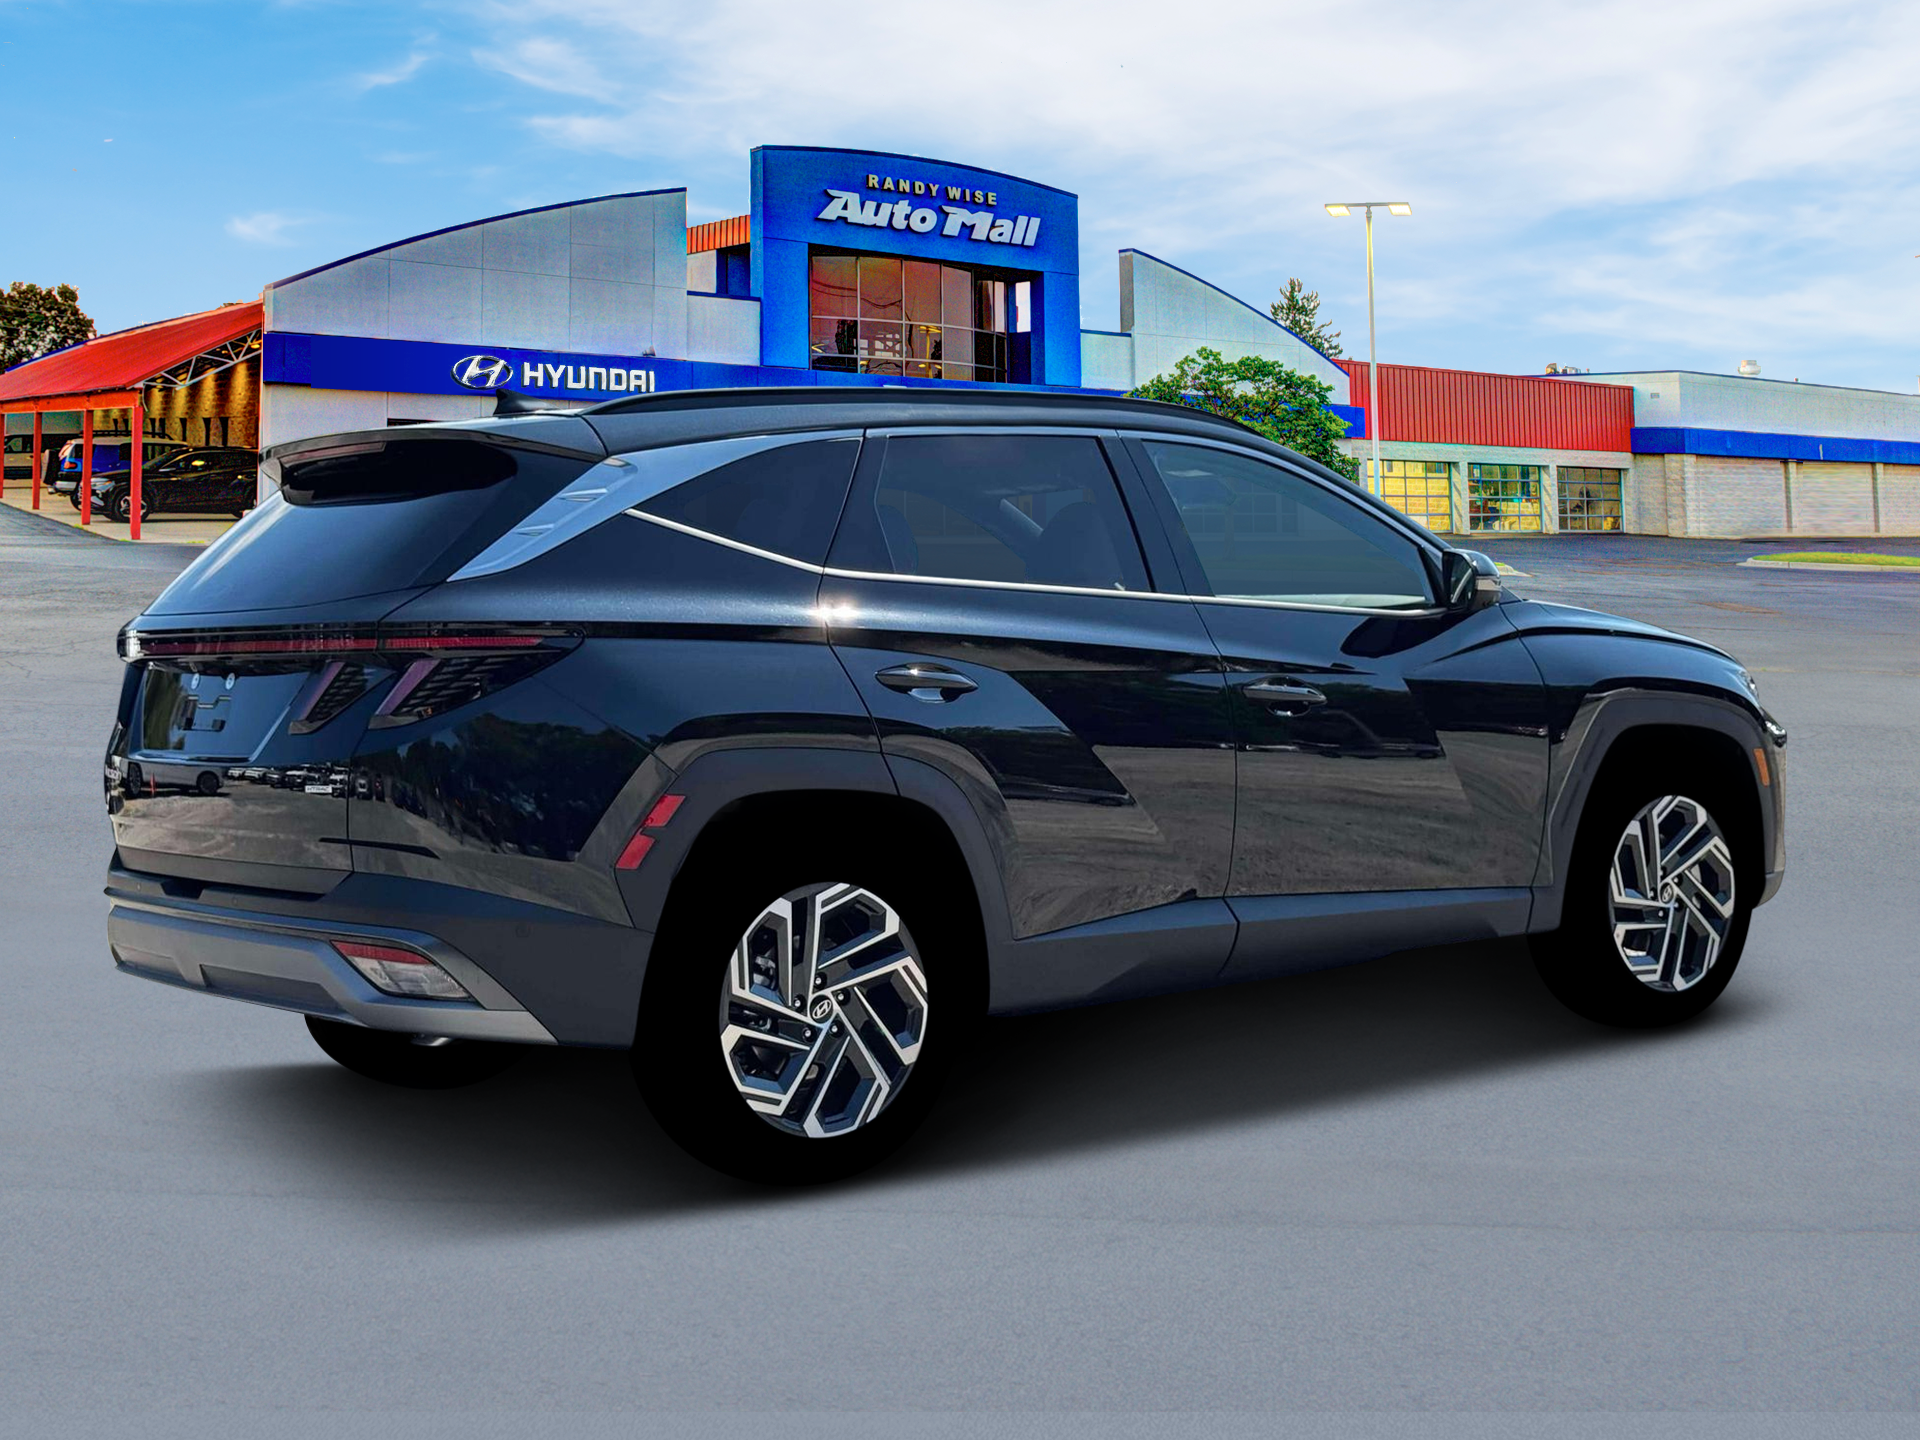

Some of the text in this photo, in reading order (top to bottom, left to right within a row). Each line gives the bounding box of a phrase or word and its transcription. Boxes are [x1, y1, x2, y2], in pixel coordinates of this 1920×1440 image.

[867, 174, 997, 205] RANDY WISE
[817, 189, 1041, 247] Auto Mall
[523, 361, 656, 393] HYUNDAI
